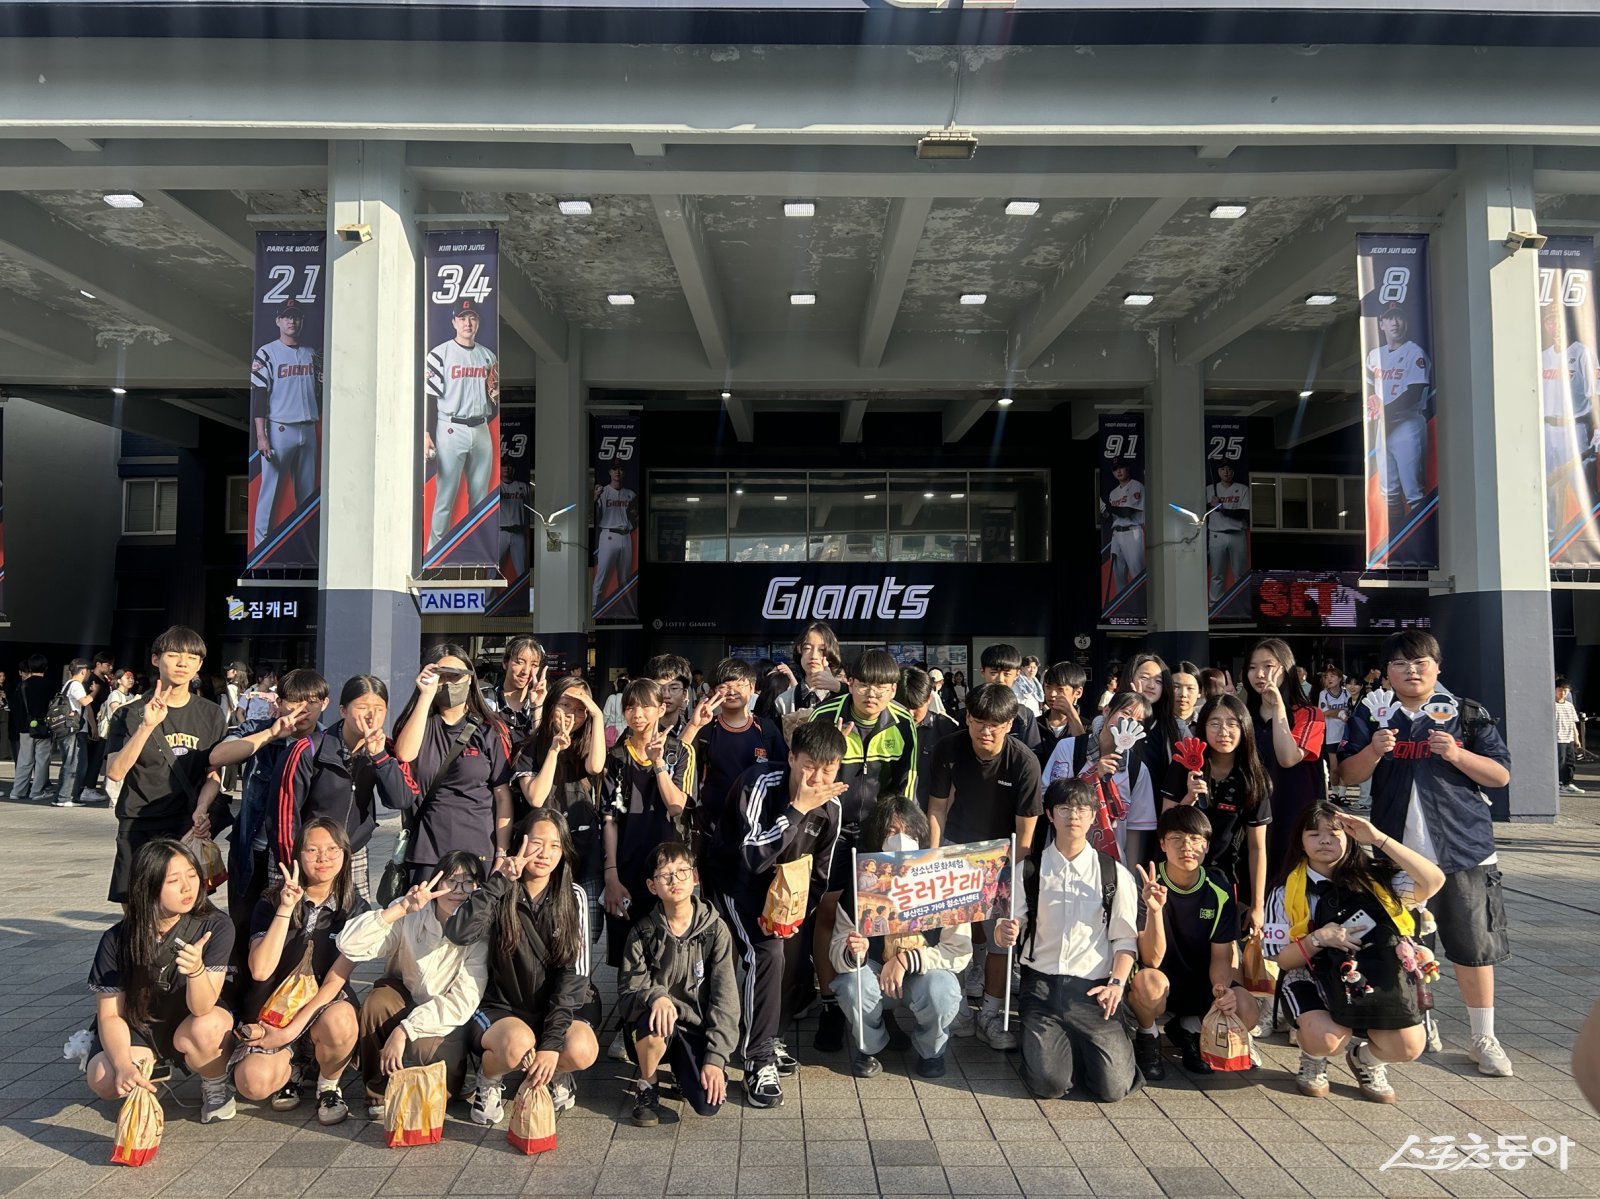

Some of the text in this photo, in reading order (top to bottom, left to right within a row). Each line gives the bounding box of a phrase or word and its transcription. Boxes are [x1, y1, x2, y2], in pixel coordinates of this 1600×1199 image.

[438, 243, 485, 252] KIM WON JUNG
[262, 265, 321, 304] 21
[431, 263, 493, 304] 34
[1378, 266, 1411, 305] 8
[1539, 268, 1589, 307] 16
[598, 436, 637, 461] 55
[1104, 434, 1139, 459] 91
[1207, 436, 1245, 460] 25
[248, 600, 298, 619] 짐캐리
[762, 576, 935, 619] Giants
[910, 859, 965, 878] 청소년문화체험
[891, 869, 982, 911] 놀러갈래
[902, 892, 980, 919] 부산진구 가야 청소년센터
